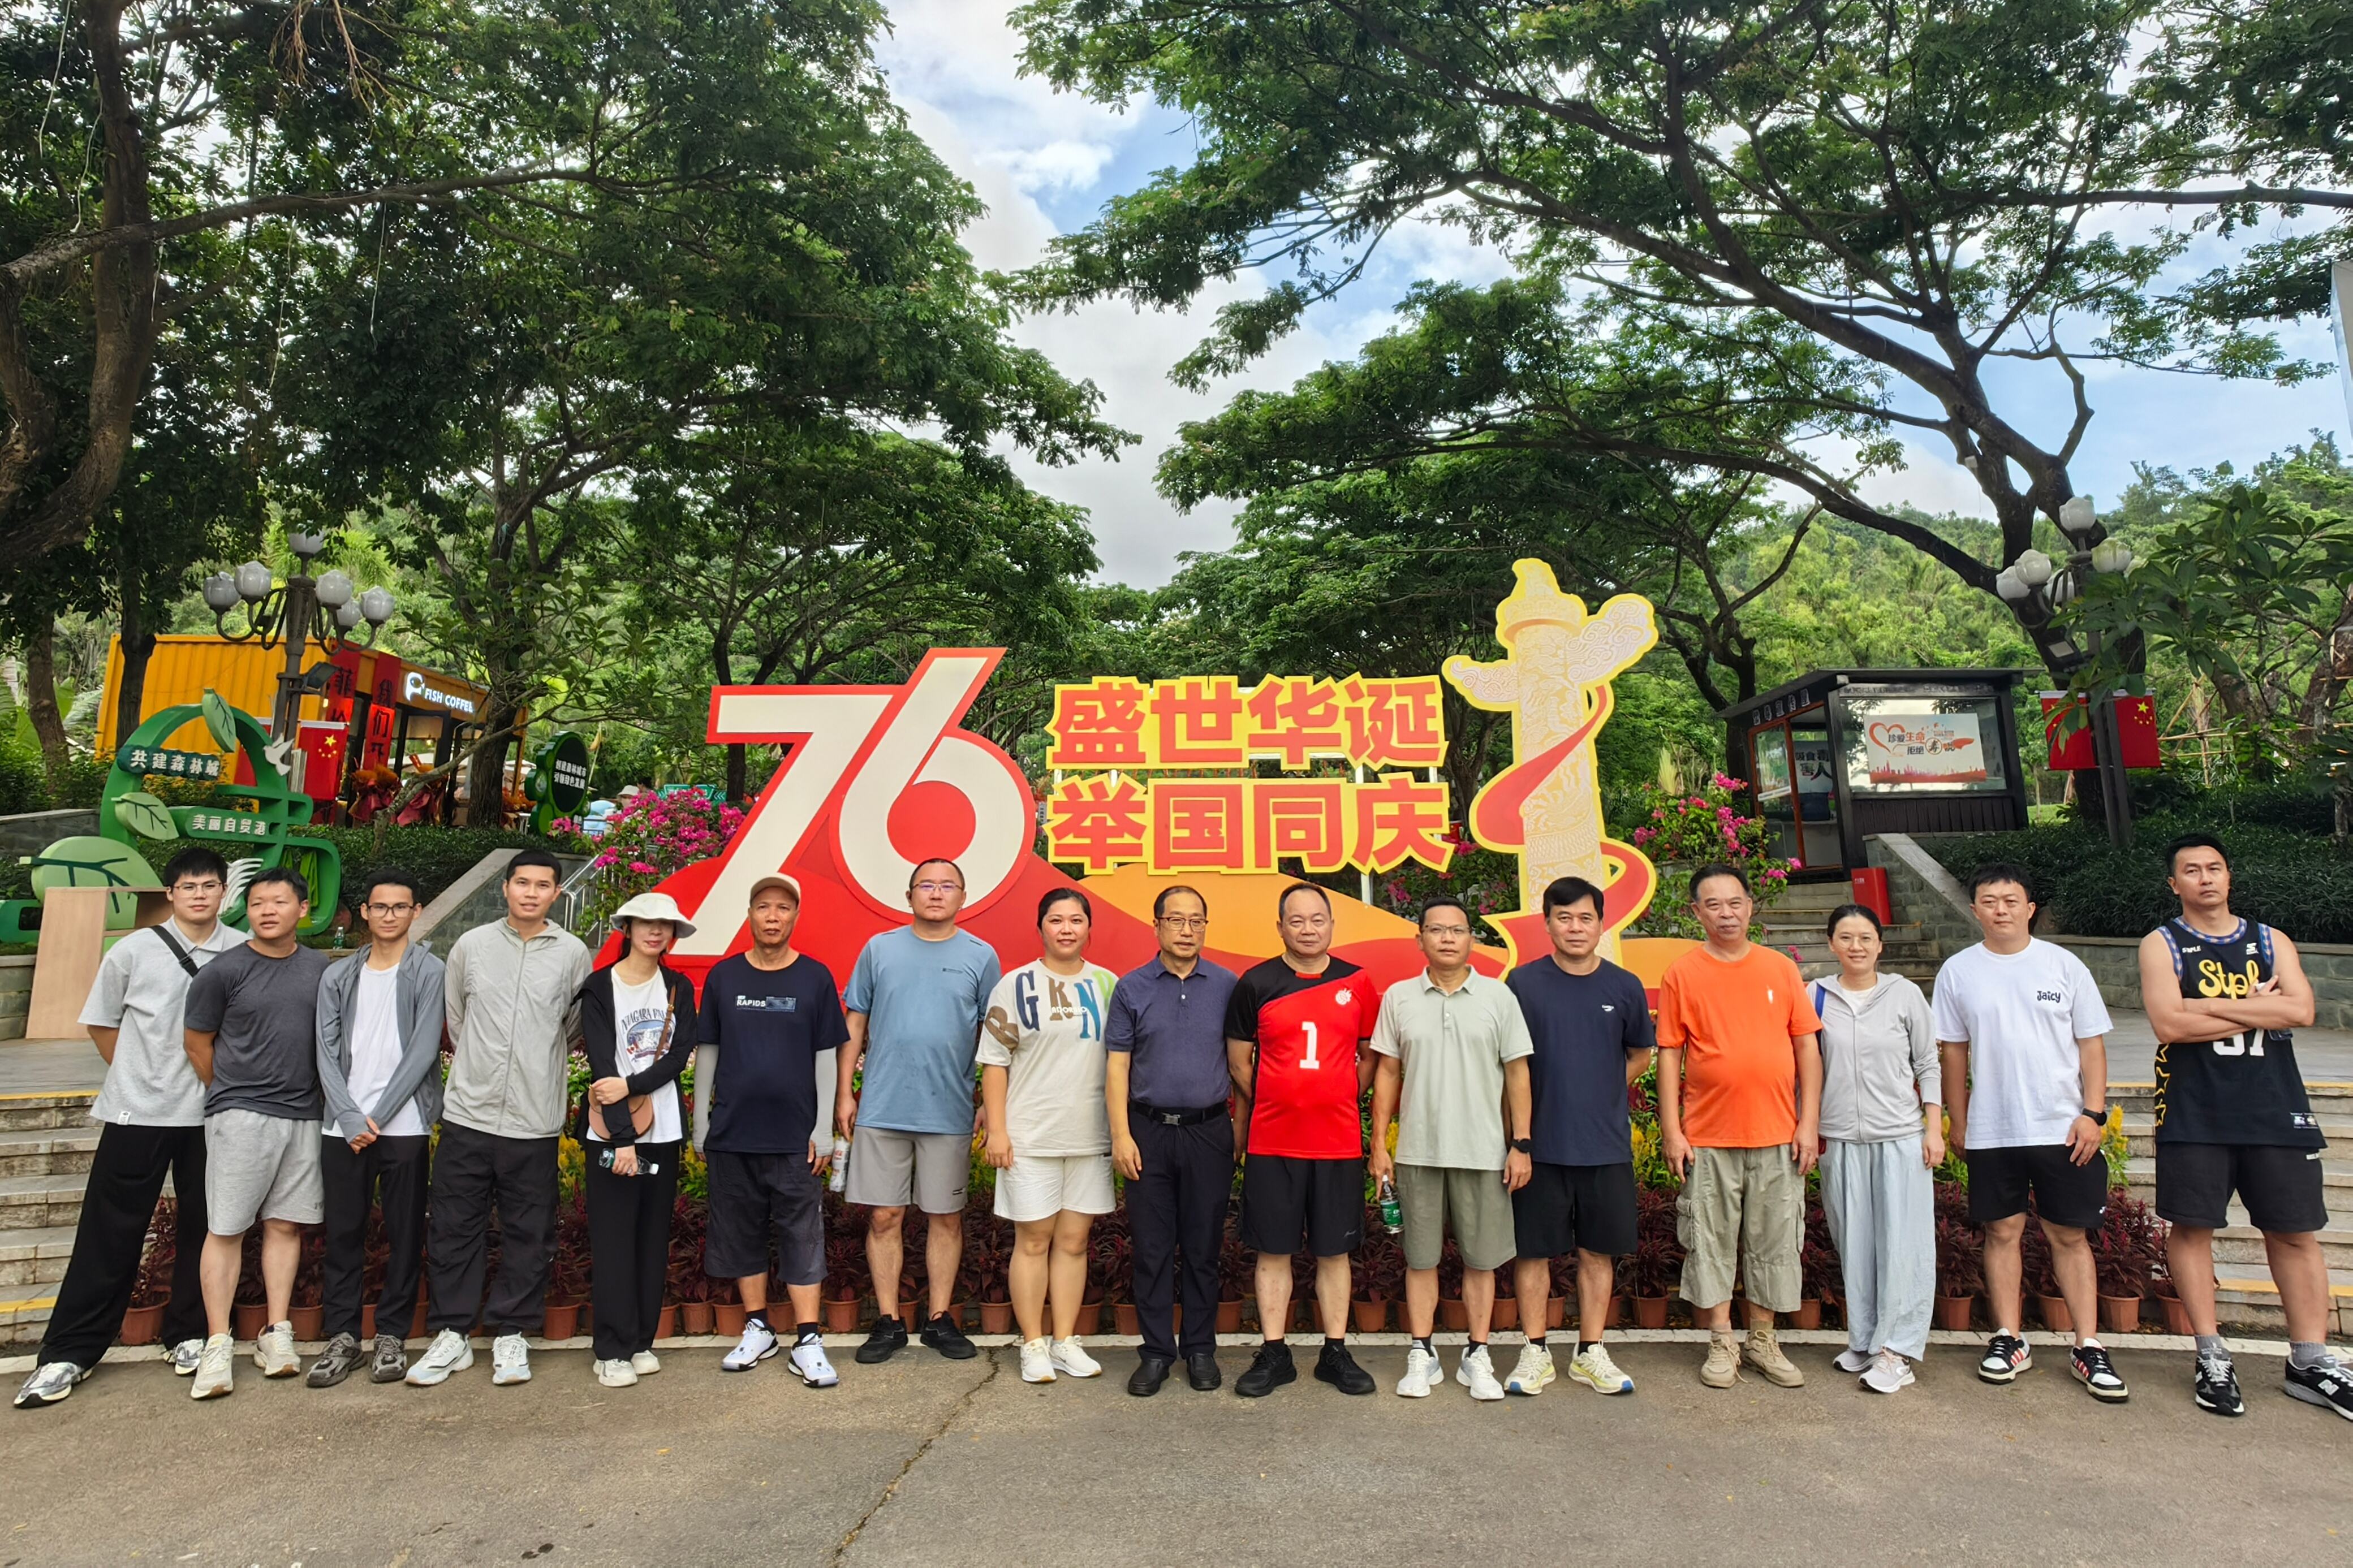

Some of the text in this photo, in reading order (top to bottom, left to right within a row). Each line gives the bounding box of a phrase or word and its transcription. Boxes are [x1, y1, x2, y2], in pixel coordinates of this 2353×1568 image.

[425, 688, 443, 703] FISH
[1053, 679, 1438, 763] 盛世华诞
[193, 814, 266, 836] 美丽自贸港
[671, 657, 1022, 956] 76
[1049, 778, 1450, 870] 举国同庆
[2037, 991, 2061, 1003] Jaicy
[1300, 1021, 1320, 1069] 1
